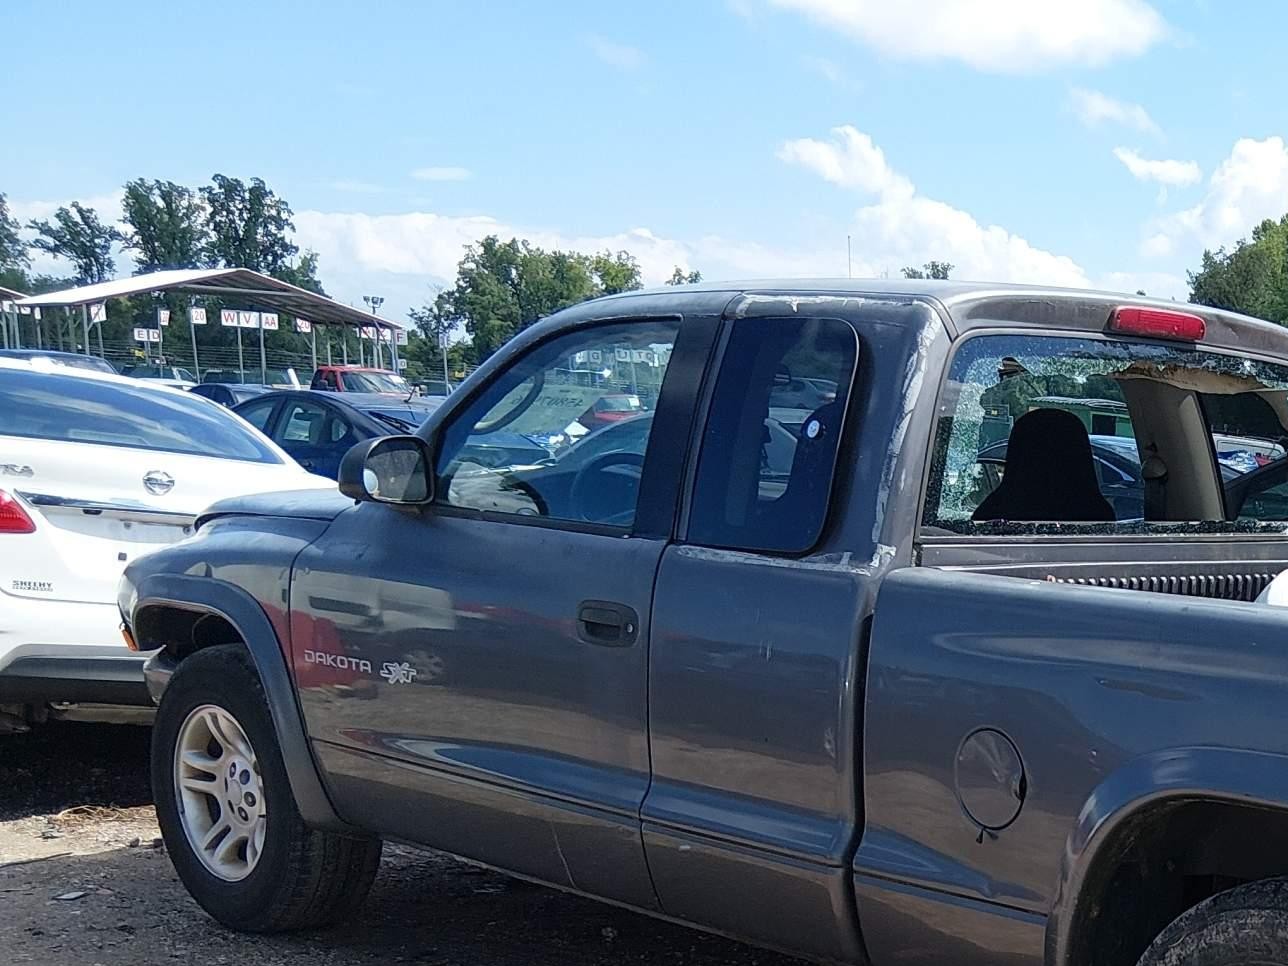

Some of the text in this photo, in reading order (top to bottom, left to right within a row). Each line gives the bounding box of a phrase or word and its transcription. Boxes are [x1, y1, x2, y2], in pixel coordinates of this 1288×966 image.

[194, 310, 205, 321] 20
[223, 312, 236, 323] W
[243, 313, 252, 325] V
[264, 316, 276, 328] AA
[137, 330, 145, 339] E
[304, 650, 417, 685] DAKOTA SXT
